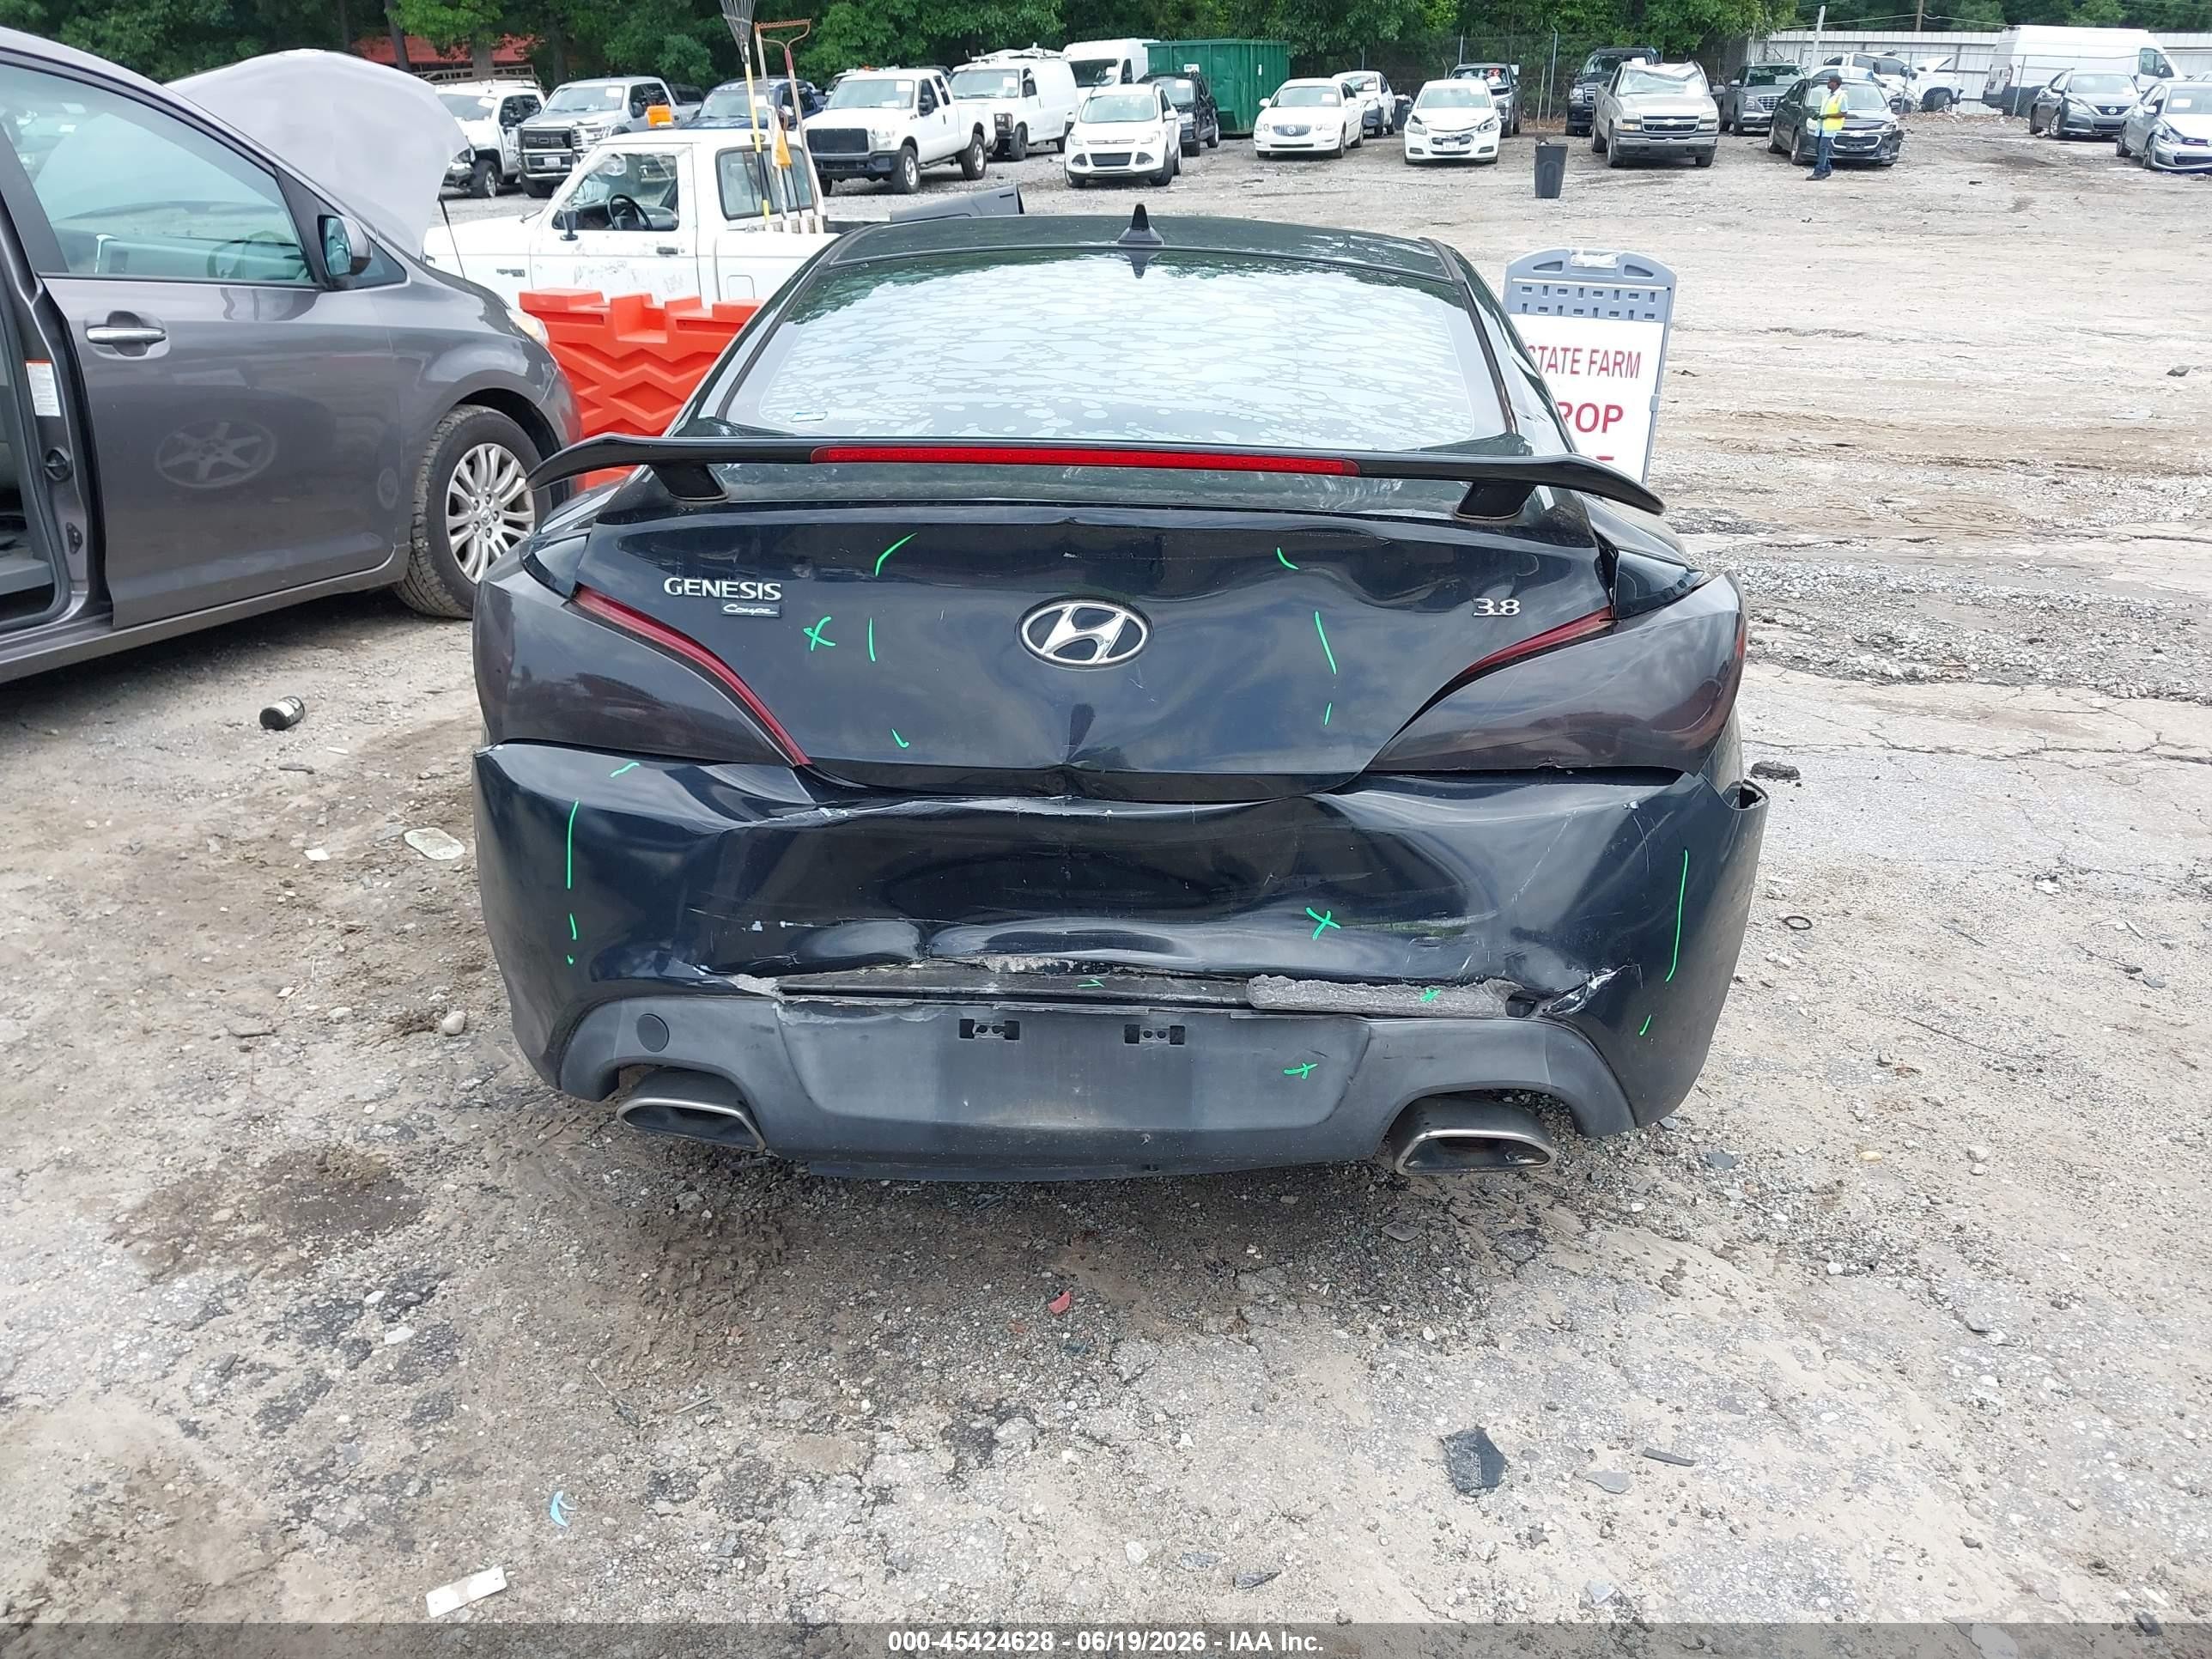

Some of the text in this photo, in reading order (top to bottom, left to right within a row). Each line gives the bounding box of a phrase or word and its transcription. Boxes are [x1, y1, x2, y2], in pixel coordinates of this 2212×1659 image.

[1587, 348, 1642, 379] FARM
[663, 576, 782, 601] GENESIS
[722, 603, 778, 617] Coupe
